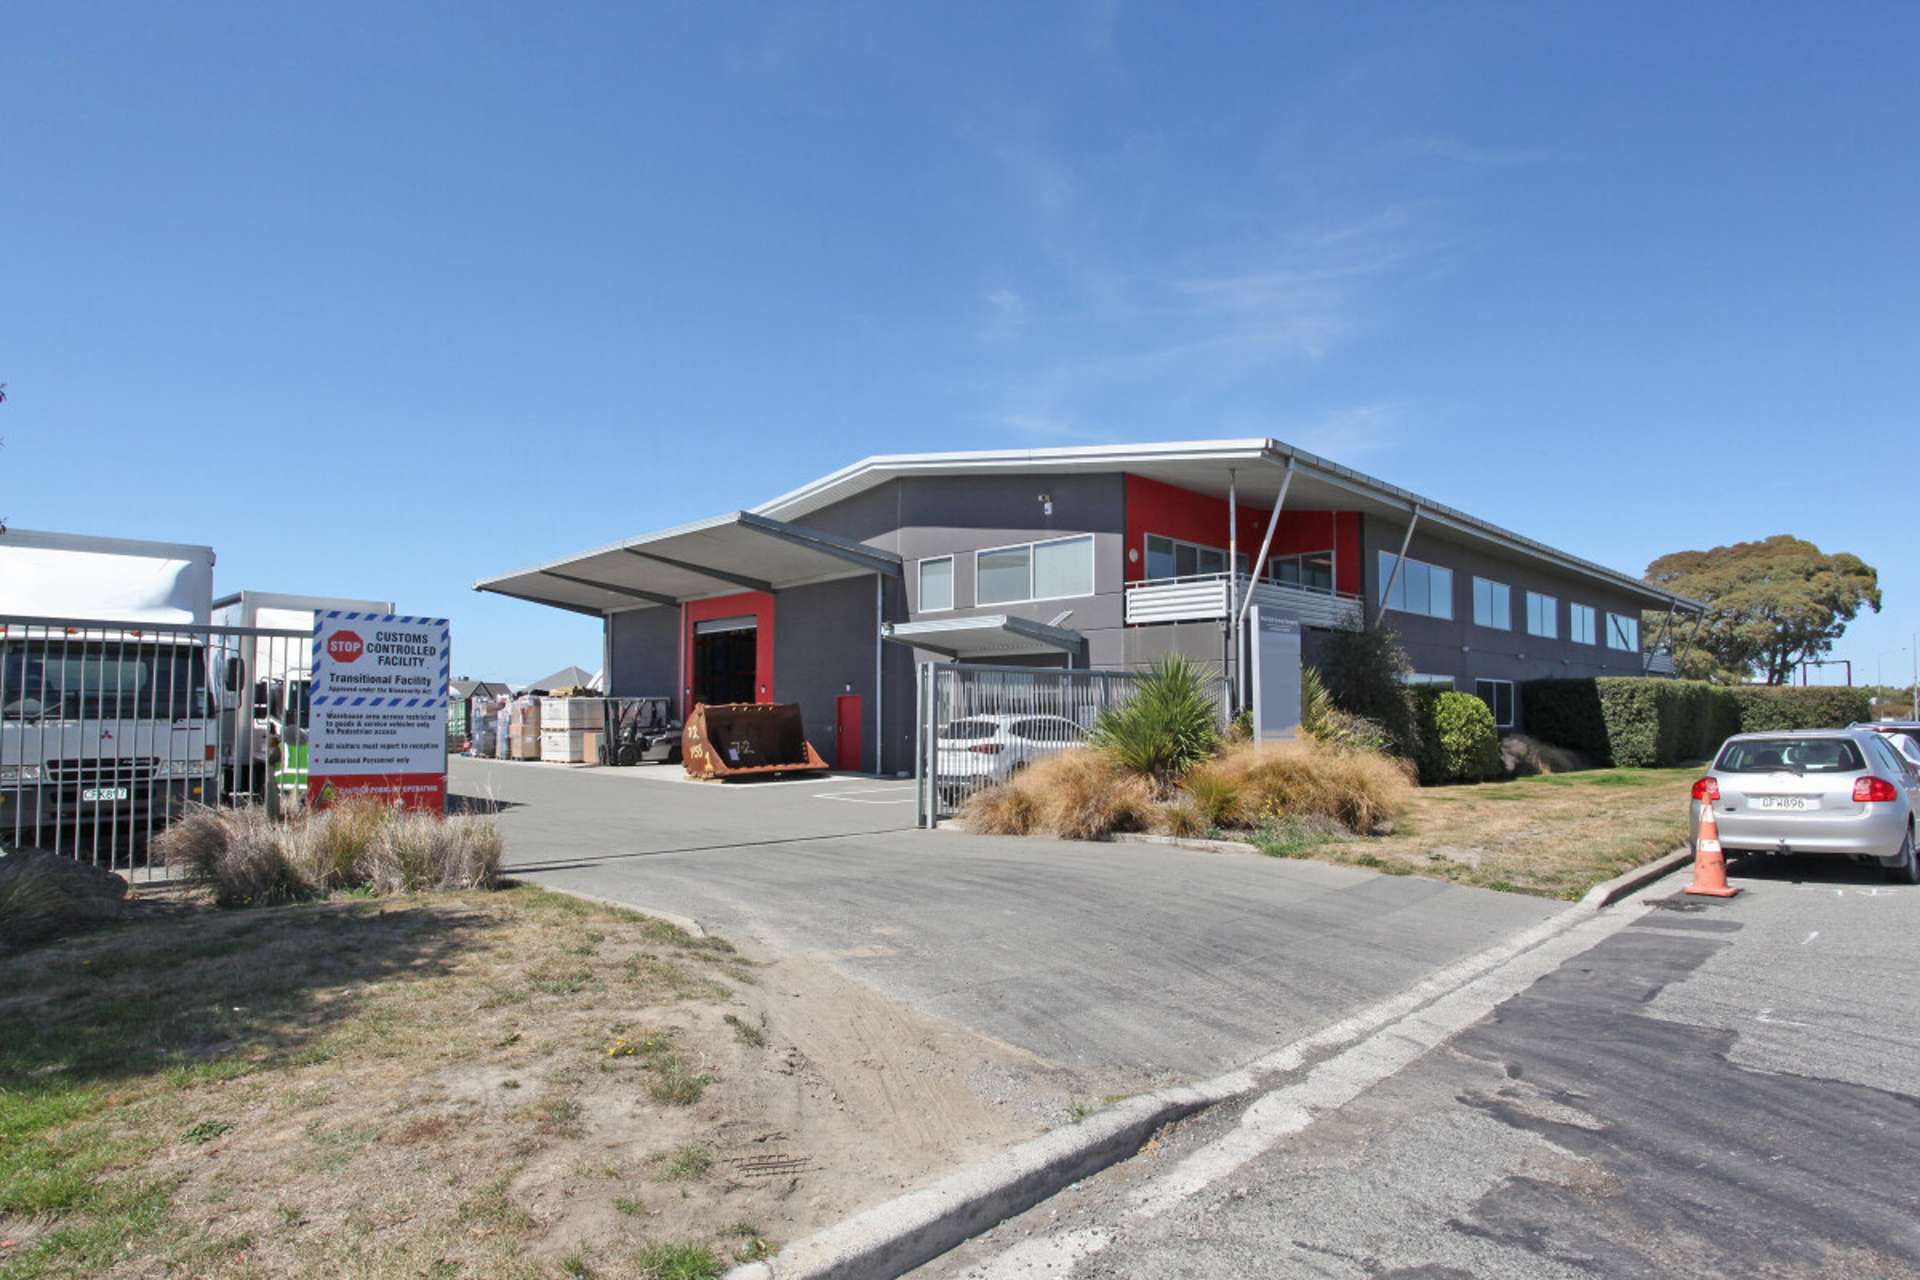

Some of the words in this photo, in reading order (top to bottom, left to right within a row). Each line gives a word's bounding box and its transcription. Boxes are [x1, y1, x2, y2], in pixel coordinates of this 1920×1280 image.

[376, 631, 428, 643] CUSTOMS
[330, 641, 361, 652] STOP
[367, 643, 436, 656] CONTROLLED
[377, 656, 425, 667] FACILITY
[329, 673, 393, 684] Transitional
[395, 675, 432, 687] Facility
